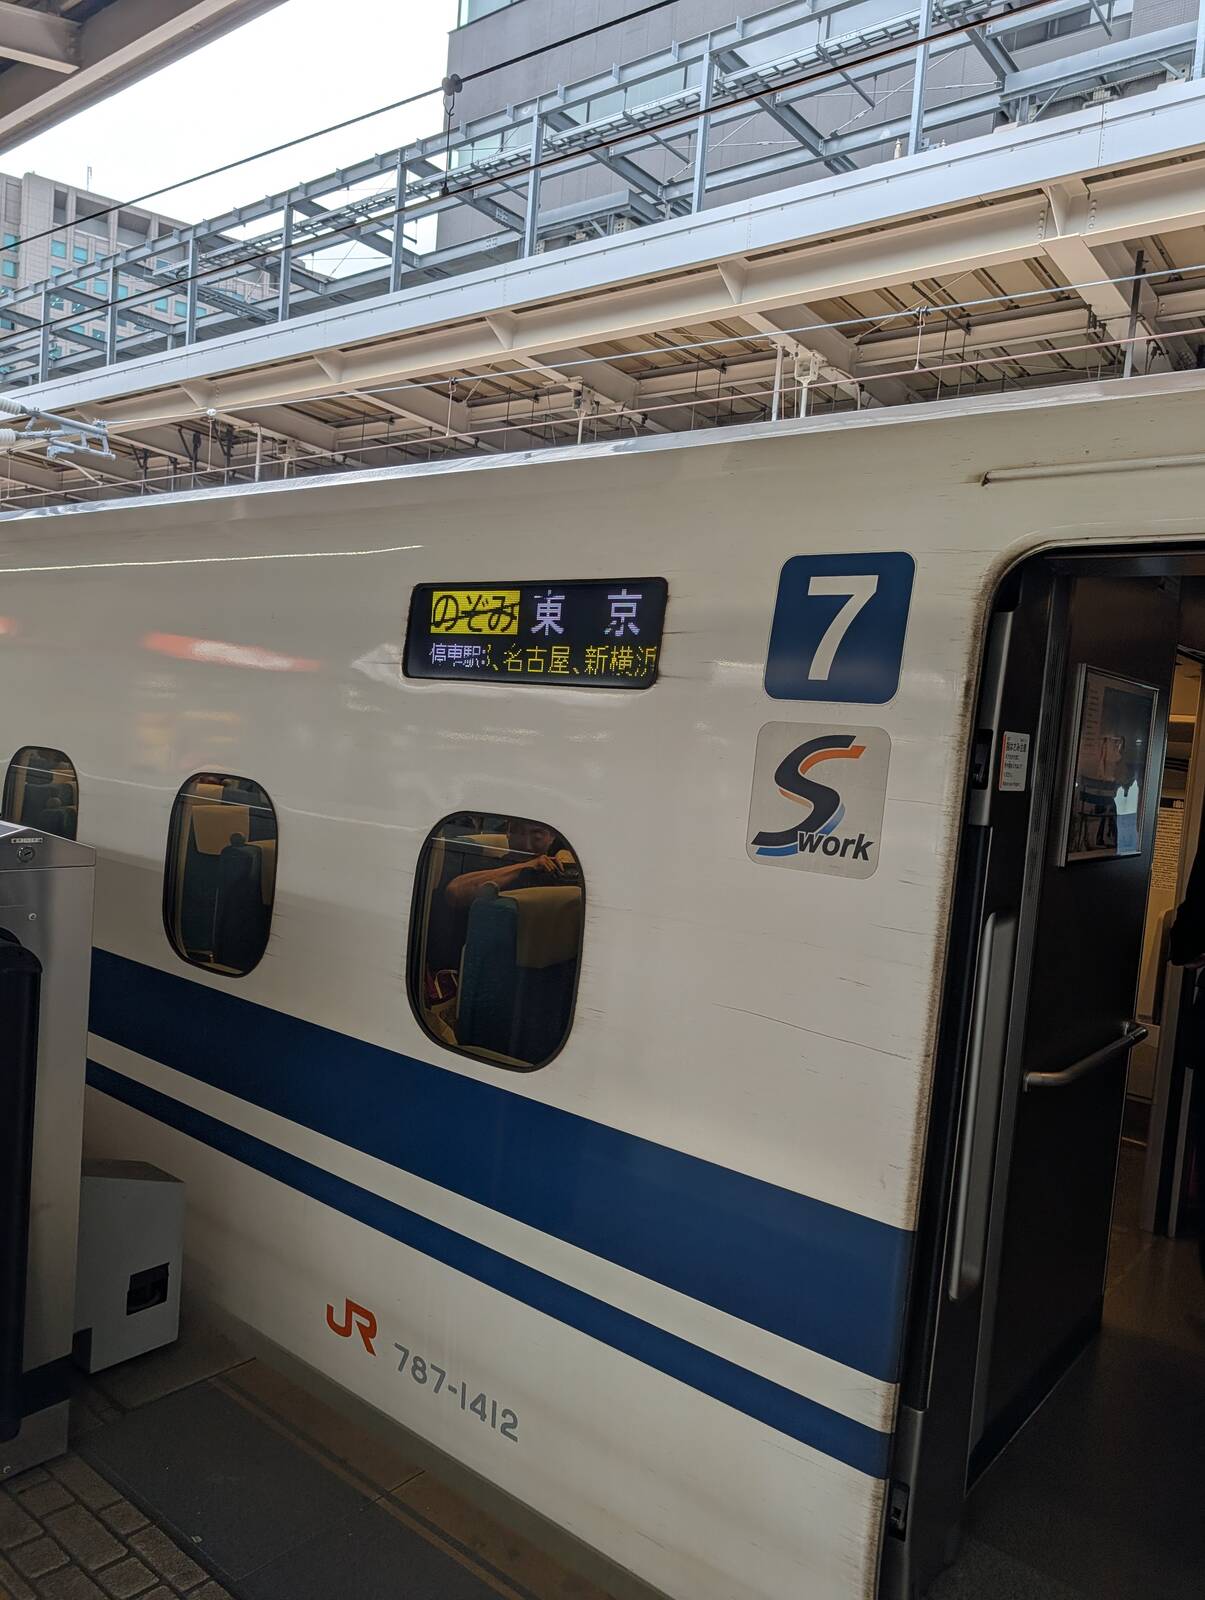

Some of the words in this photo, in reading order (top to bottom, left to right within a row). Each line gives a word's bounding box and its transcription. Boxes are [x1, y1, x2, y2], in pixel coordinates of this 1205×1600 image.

[431, 593, 520, 633] のぞみ
[807, 574, 879, 681] 7
[751, 735, 867, 857] S
[326, 1297, 377, 1357] JR
[394, 1342, 519, 1443] 787-1412
